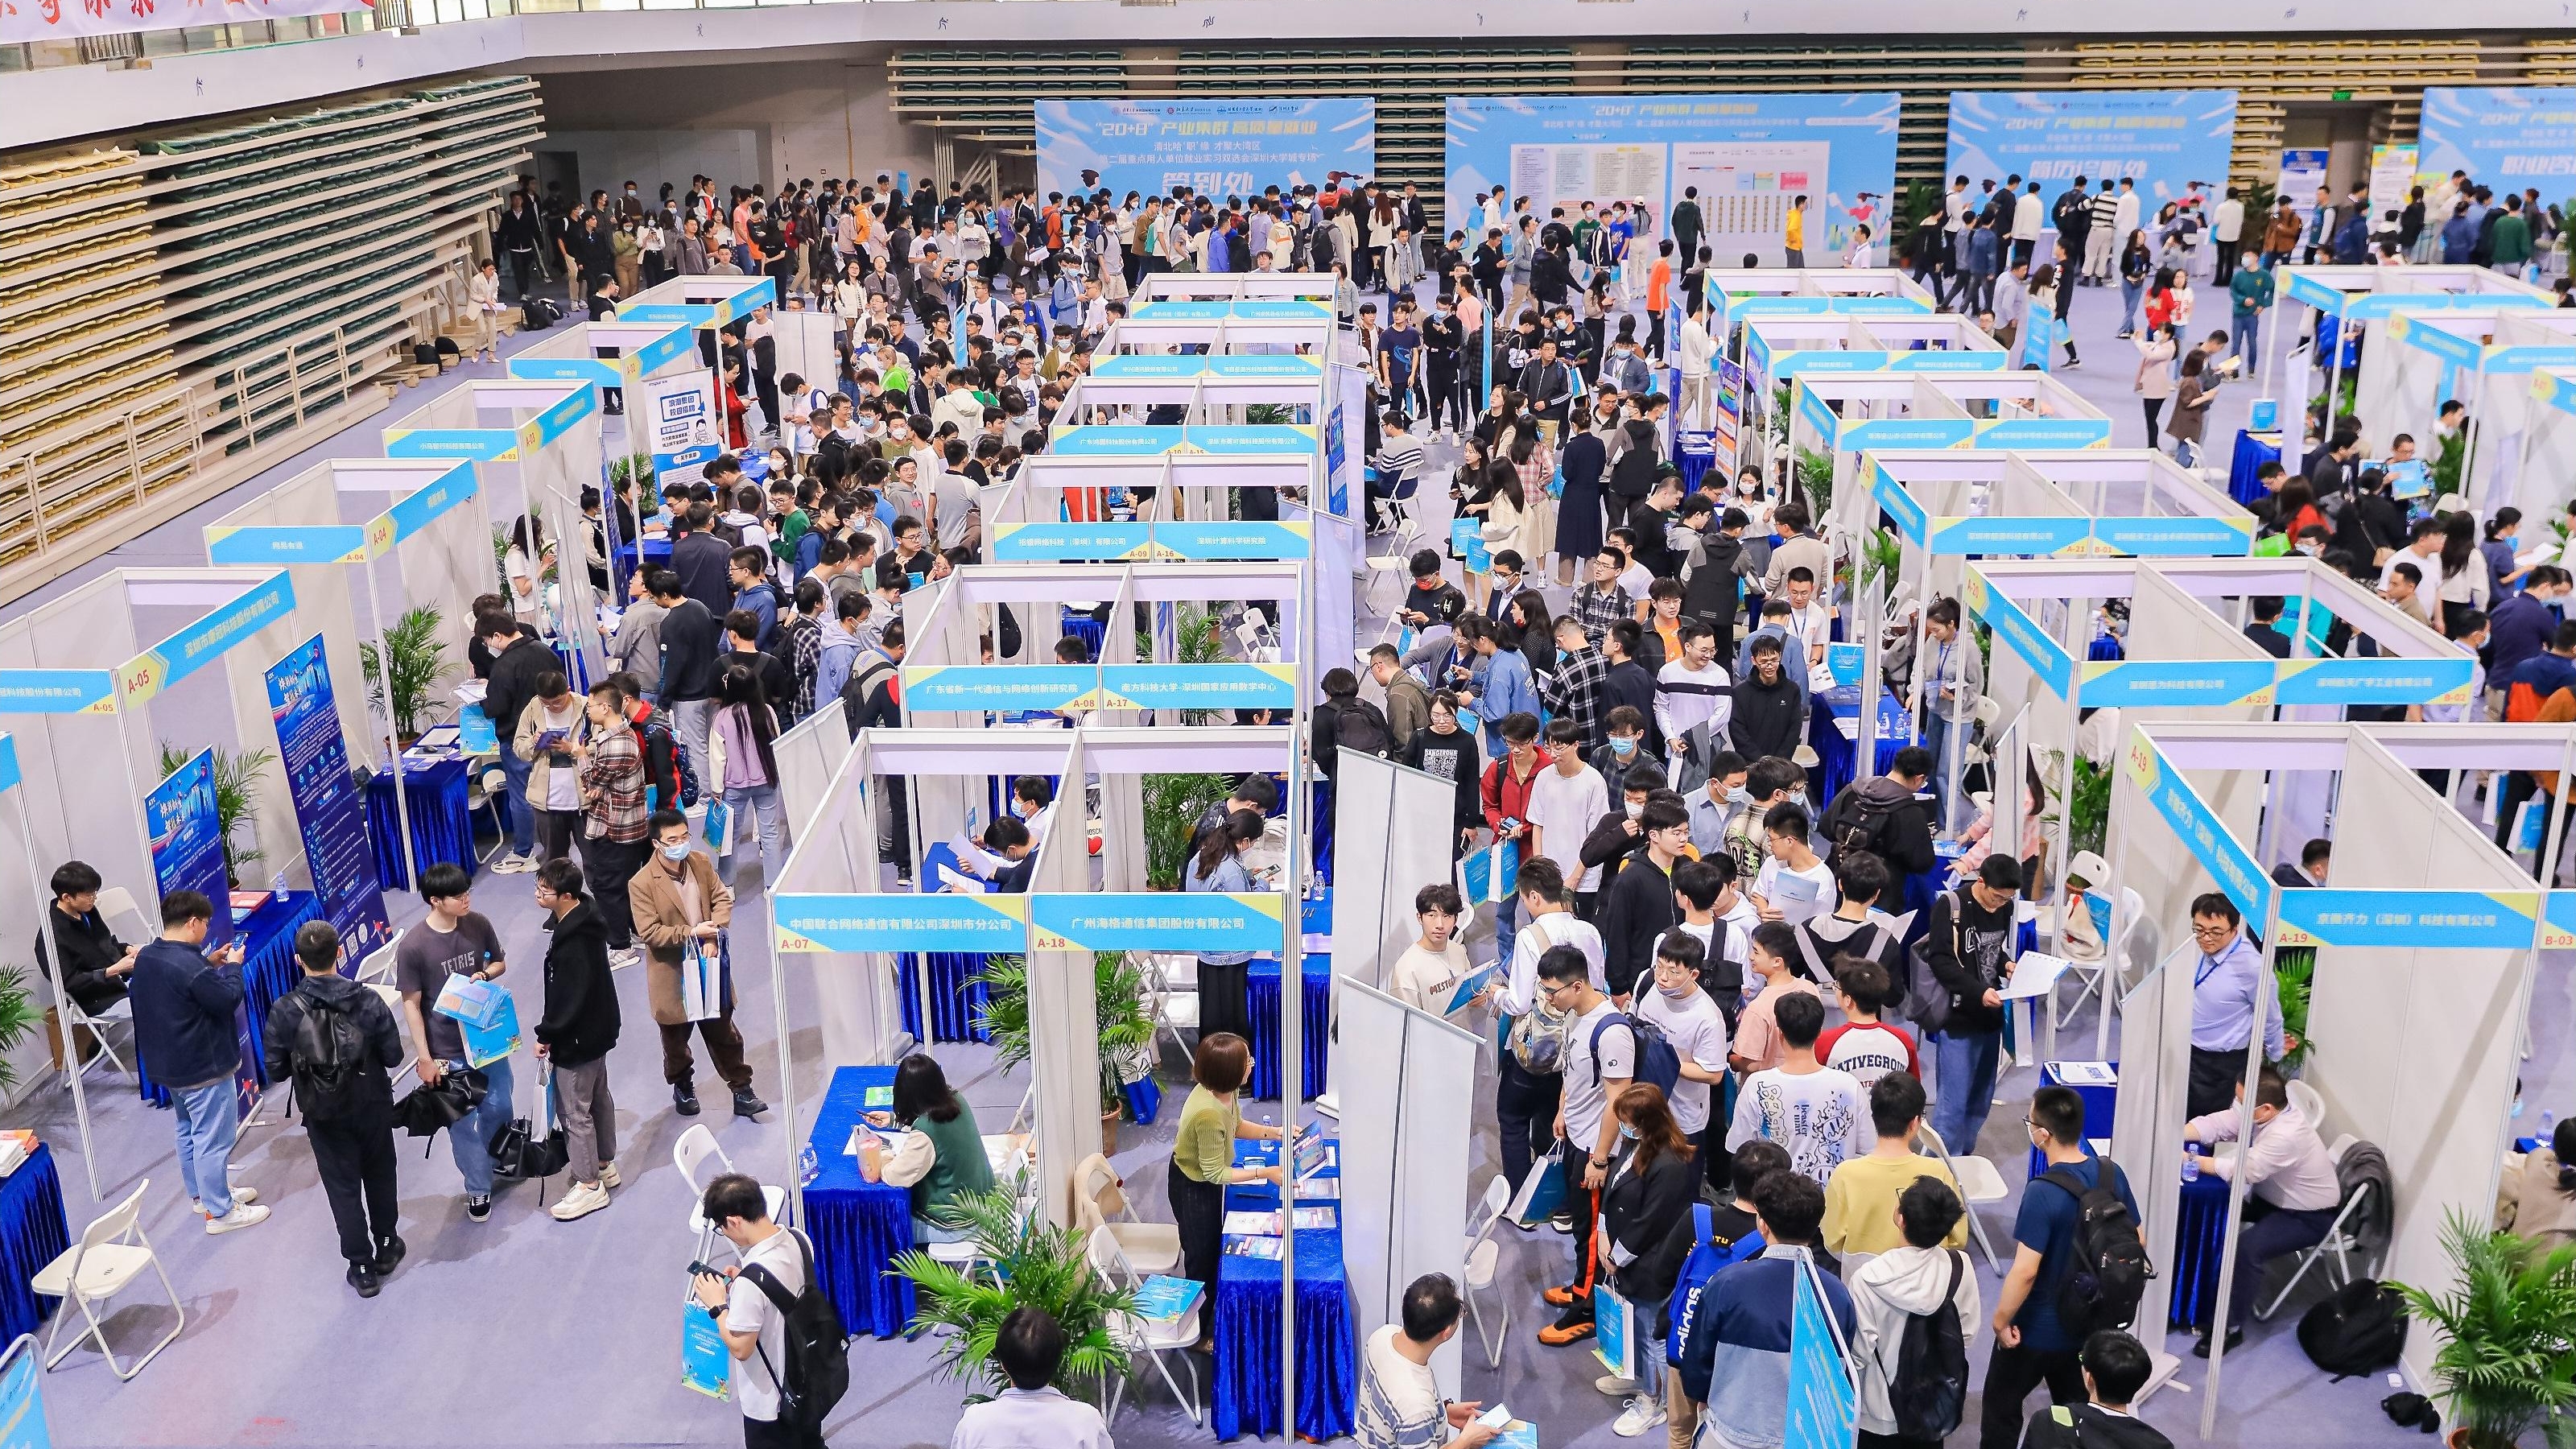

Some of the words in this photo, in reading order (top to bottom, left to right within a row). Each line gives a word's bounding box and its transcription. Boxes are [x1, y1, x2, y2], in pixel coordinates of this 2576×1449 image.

[526, 432, 535, 447] A-03
[374, 526, 387, 546] A-04
[1196, 536, 1266, 546] 深圳计算科学研究院
[128, 670, 150, 694] A-05
[927, 683, 1079, 694] 广东省新一代通信与网络创新研究院
[2245, 696, 2268, 704] A-20
[2444, 694, 2467, 702] B-02
[93, 704, 114, 712] A-05
[2131, 745, 2148, 772] A-19
[791, 919, 1012, 931] 中国联合网络通信有限公司深圳市分公司
[1071, 918, 1245, 929] 广州海格通信集团股份有限公司
[781, 939, 809, 948] A-07
[1038, 939, 1065, 947] A-18
[2280, 933, 2308, 943] A-19
[2545, 936, 2573, 945] B-03
[440, 952, 475, 976] TETRIS
[1642, 1011, 1660, 1025] CHALLENGE
